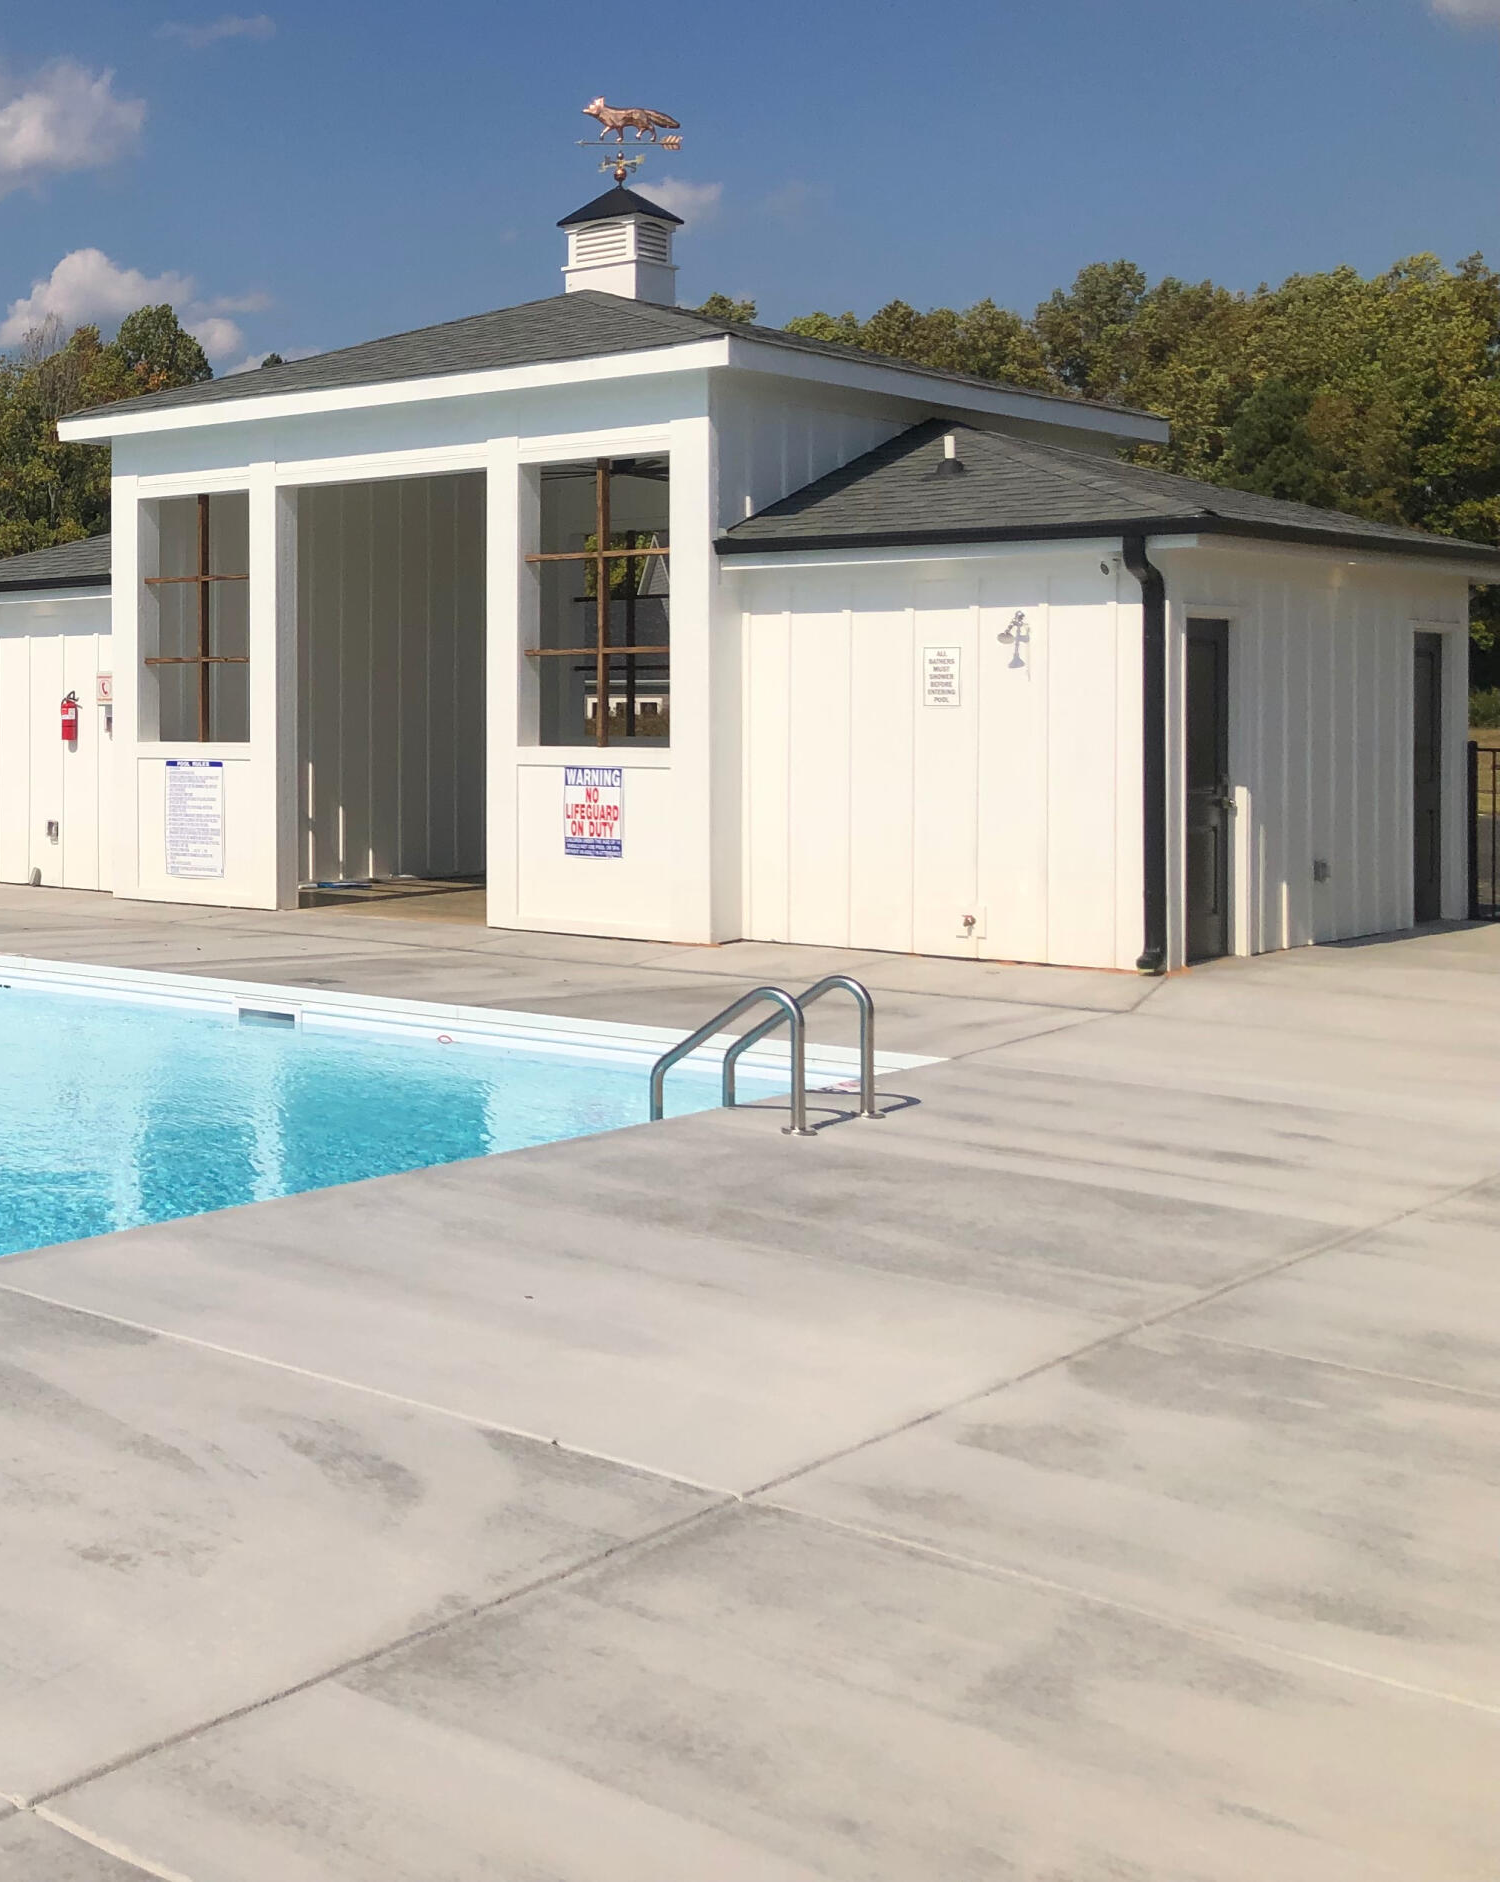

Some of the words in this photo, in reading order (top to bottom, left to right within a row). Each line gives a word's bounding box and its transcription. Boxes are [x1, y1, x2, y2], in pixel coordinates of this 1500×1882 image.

[566, 769, 621, 786] WARNING
[585, 787, 599, 803] NO
[565, 803, 619, 821] LIFEGUARD
[571, 820, 584, 837] ON
[589, 821, 614, 838] DUTY
